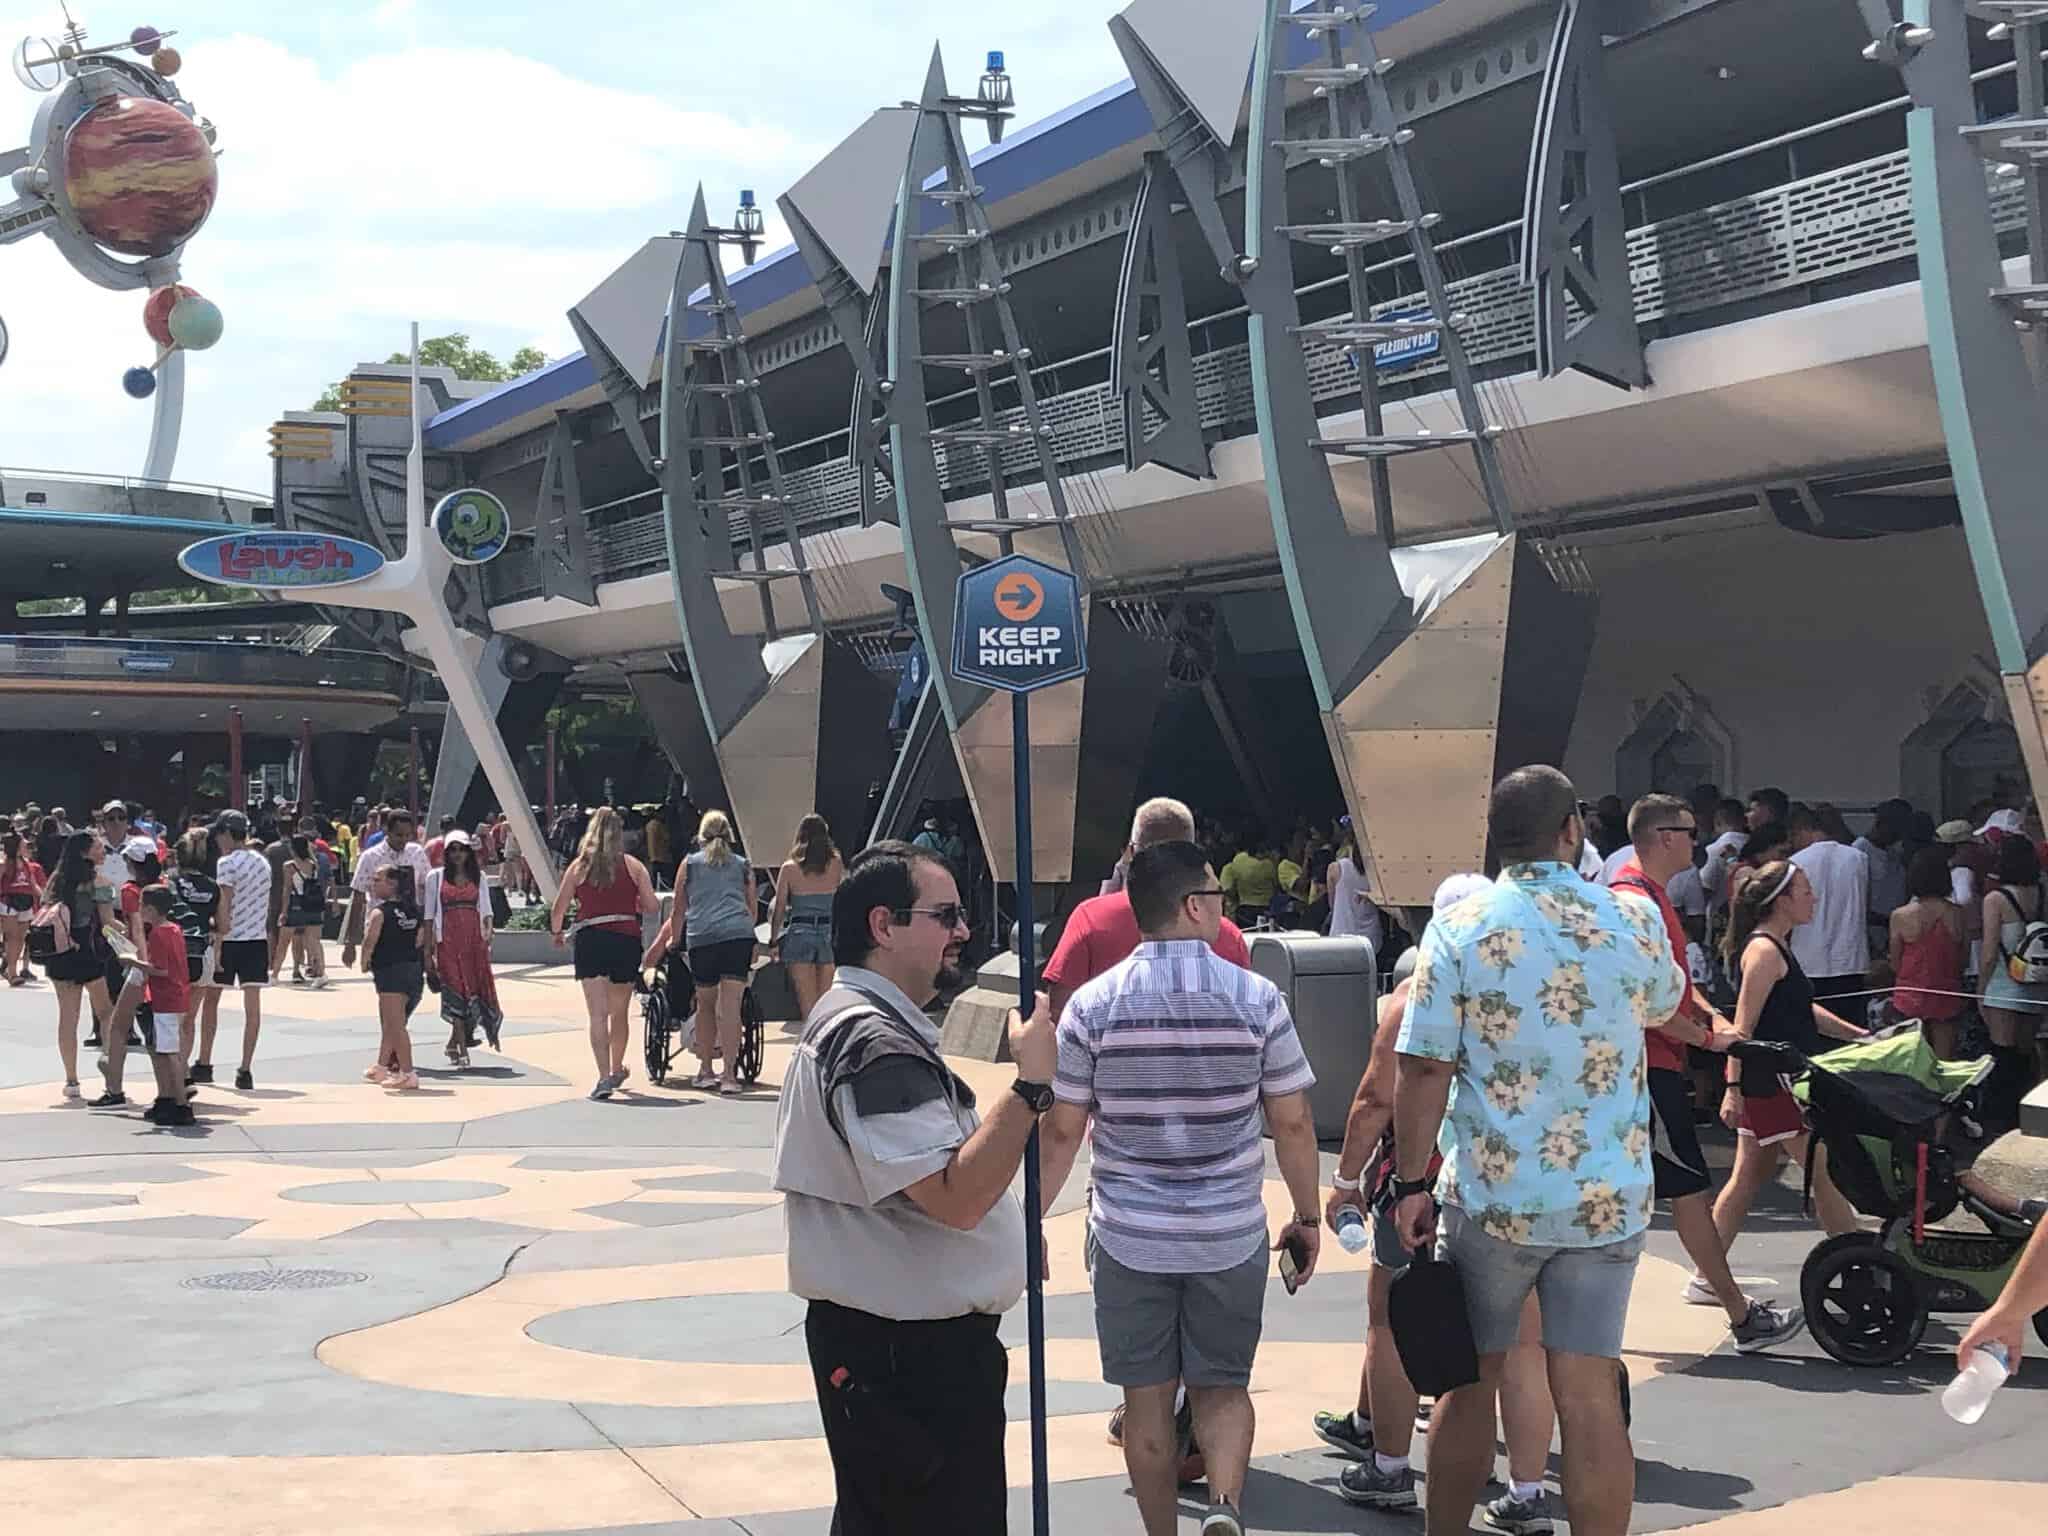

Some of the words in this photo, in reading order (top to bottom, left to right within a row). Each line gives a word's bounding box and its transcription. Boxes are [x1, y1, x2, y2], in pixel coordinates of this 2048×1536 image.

[219, 541, 353, 578] Laugh
[979, 627, 1061, 646] KEEP
[979, 648, 1062, 666] RIGHT
